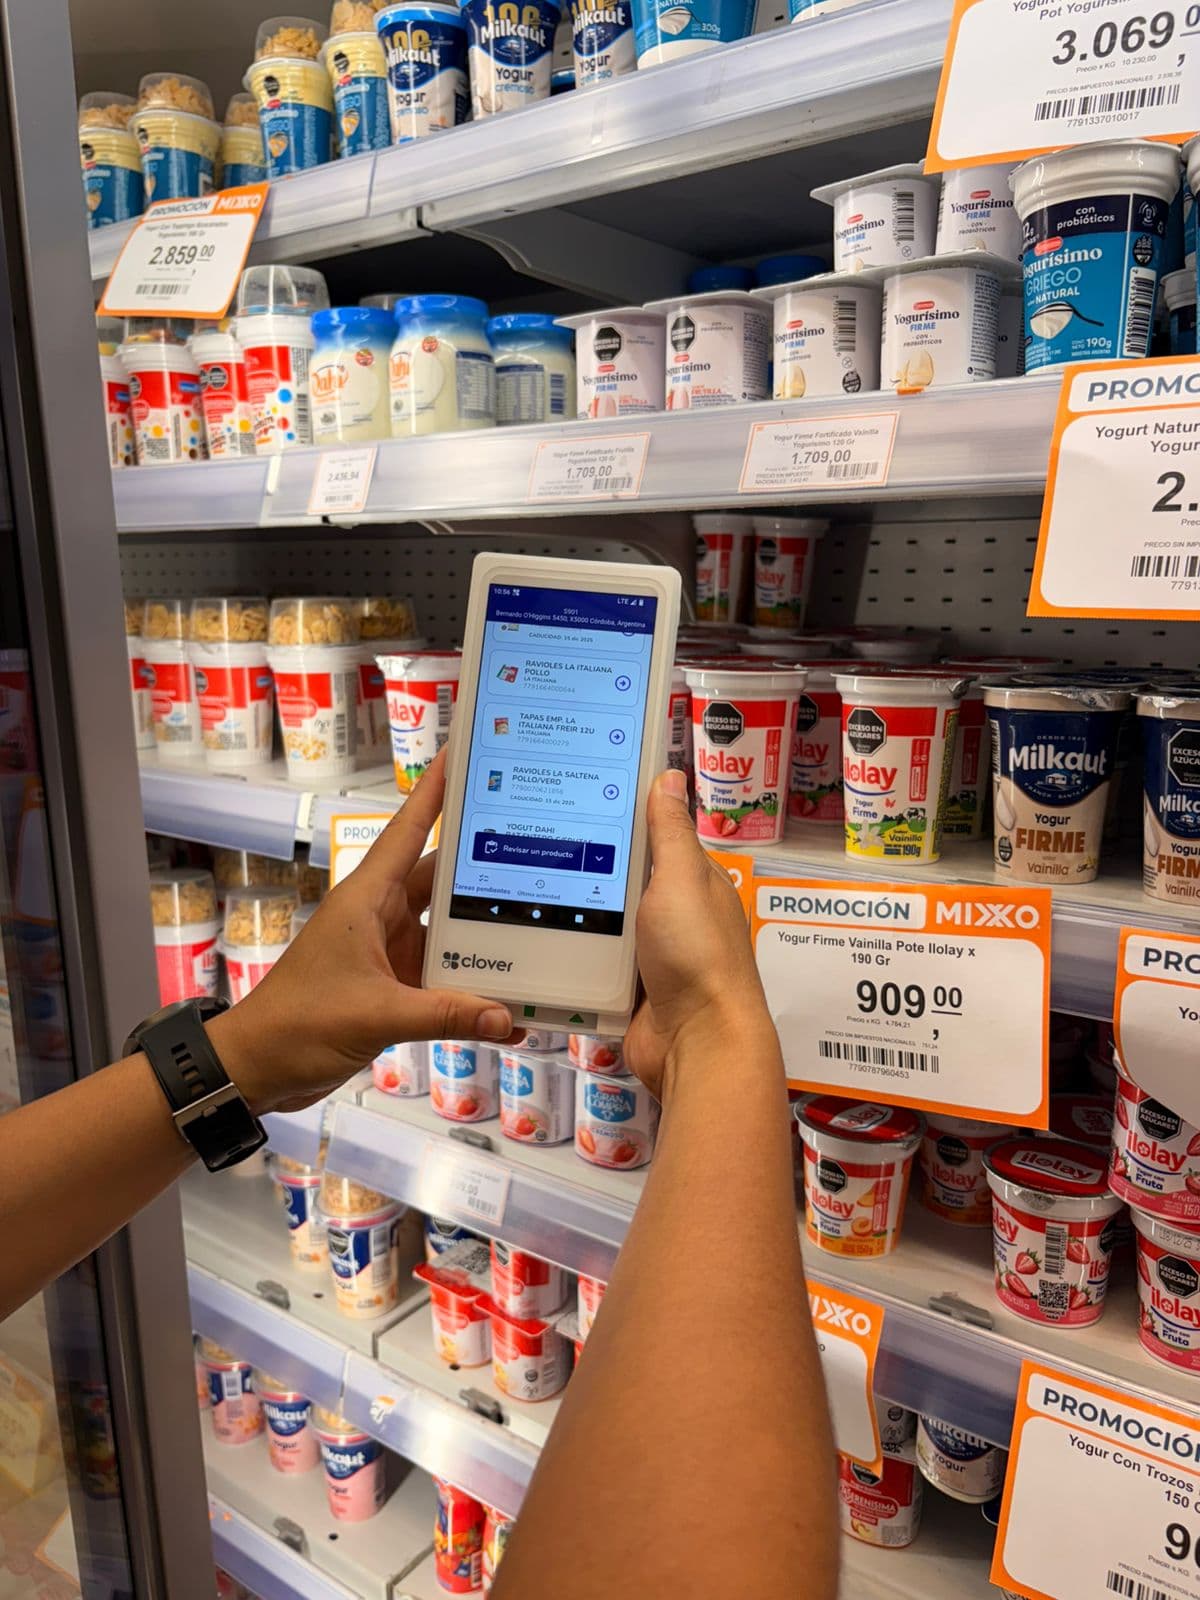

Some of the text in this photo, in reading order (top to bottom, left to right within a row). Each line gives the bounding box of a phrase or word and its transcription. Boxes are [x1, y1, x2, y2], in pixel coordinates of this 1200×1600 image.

[1040, 7, 1062, 20] Pot
[481, 20, 547, 47] Milkaut
[1052, 11, 1175, 65] 3.069
[1105, 61, 1116, 69] KG
[495, 67, 534, 82] Yogur
[1046, 86, 1069, 95] PRECIO
[1080, 81, 1113, 91] IMPUESTOS
[1115, 75, 1154, 85] NACIONALES
[1067, 112, 1140, 127] 7791337010017
[951, 199, 1014, 215] Yogurísimo
[1076, 206, 1096, 215] con
[966, 210, 991, 220] FIRME
[1056, 213, 1116, 231] probióticos
[148, 245, 215, 265] 2.859 00
[1026, 267, 1082, 296] GRIEGO
[1035, 286, 1080, 304] NATURAL
[894, 309, 960, 326] Yogurísimo
[910, 322, 936, 332] FIRME
[1086, 337, 1112, 349] 190g
[815, 430, 852, 439] Fortificado
[1096, 424, 1148, 440] Yogurt
[792, 449, 851, 465] 1.709,00
[567, 465, 612, 480] 1.709,00
[496, 610, 522, 618] Bernardo
[617, 619, 646, 628] Argentina
[524, 668, 551, 677] POLLO
[525, 660, 613, 674] RAVIOLES LA ITALIANA
[520, 713, 545, 722] TAPAS
[518, 722, 595, 735] ITALIANA FREIR 12U
[871, 725, 883, 733] EN
[1008, 744, 1107, 775] Milkaut
[512, 774, 562, 785] POLLO/VERD
[513, 766, 600, 781] RAVIOLES LA SALTENA
[713, 787, 733, 795] Yogur
[710, 794, 737, 805] Firme
[855, 798, 873, 807] Yogur
[853, 808, 878, 819] Firme
[1034, 813, 1071, 827] Yogur
[506, 824, 555, 834] YOGUT DAHI
[889, 834, 922, 842] Vainilla
[1015, 828, 1086, 854] FIRME
[503, 845, 529, 854] Revisar
[541, 850, 574, 859] producto
[902, 844, 920, 857] 190g
[1027, 861, 1069, 876] Vainilla
[455, 883, 511, 895] Tareas pendientes
[586, 897, 605, 905] Cuenta
[769, 895, 1040, 930] PROMOCIÓN MIXXO
[778, 931, 810, 945] Yogur
[813, 934, 845, 947] Firme
[849, 937, 892, 951] Vainilla
[896, 941, 925, 953] Pote
[968, 948, 976, 956] x
[461, 954, 514, 972] clover
[851, 952, 891, 966] 190 Gr
[856, 979, 963, 1019] 909 00
[883, 1037, 916, 1046] NACIONALES
[849, 1063, 910, 1079] 7790787960453
[1139, 1114, 1176, 1131] AZÚCARES
[1140, 1107, 1178, 1125] EXCESO EN
[1127, 1130, 1187, 1171] ilolay
[1020, 1152, 1094, 1180] ilolay
[1135, 1173, 1163, 1191] Fruta
[812, 1186, 855, 1219] ilolay
[1160, 1263, 1198, 1281] EXCESO EN
[1162, 1329, 1190, 1346] Fruta
[935, 1452, 967, 1473] Yogur
[1069, 1434, 1194, 1493] Yogur Con Trozos
[1164, 1490, 1190, 1508] 150
[1118, 1562, 1141, 1576] PRECIO
